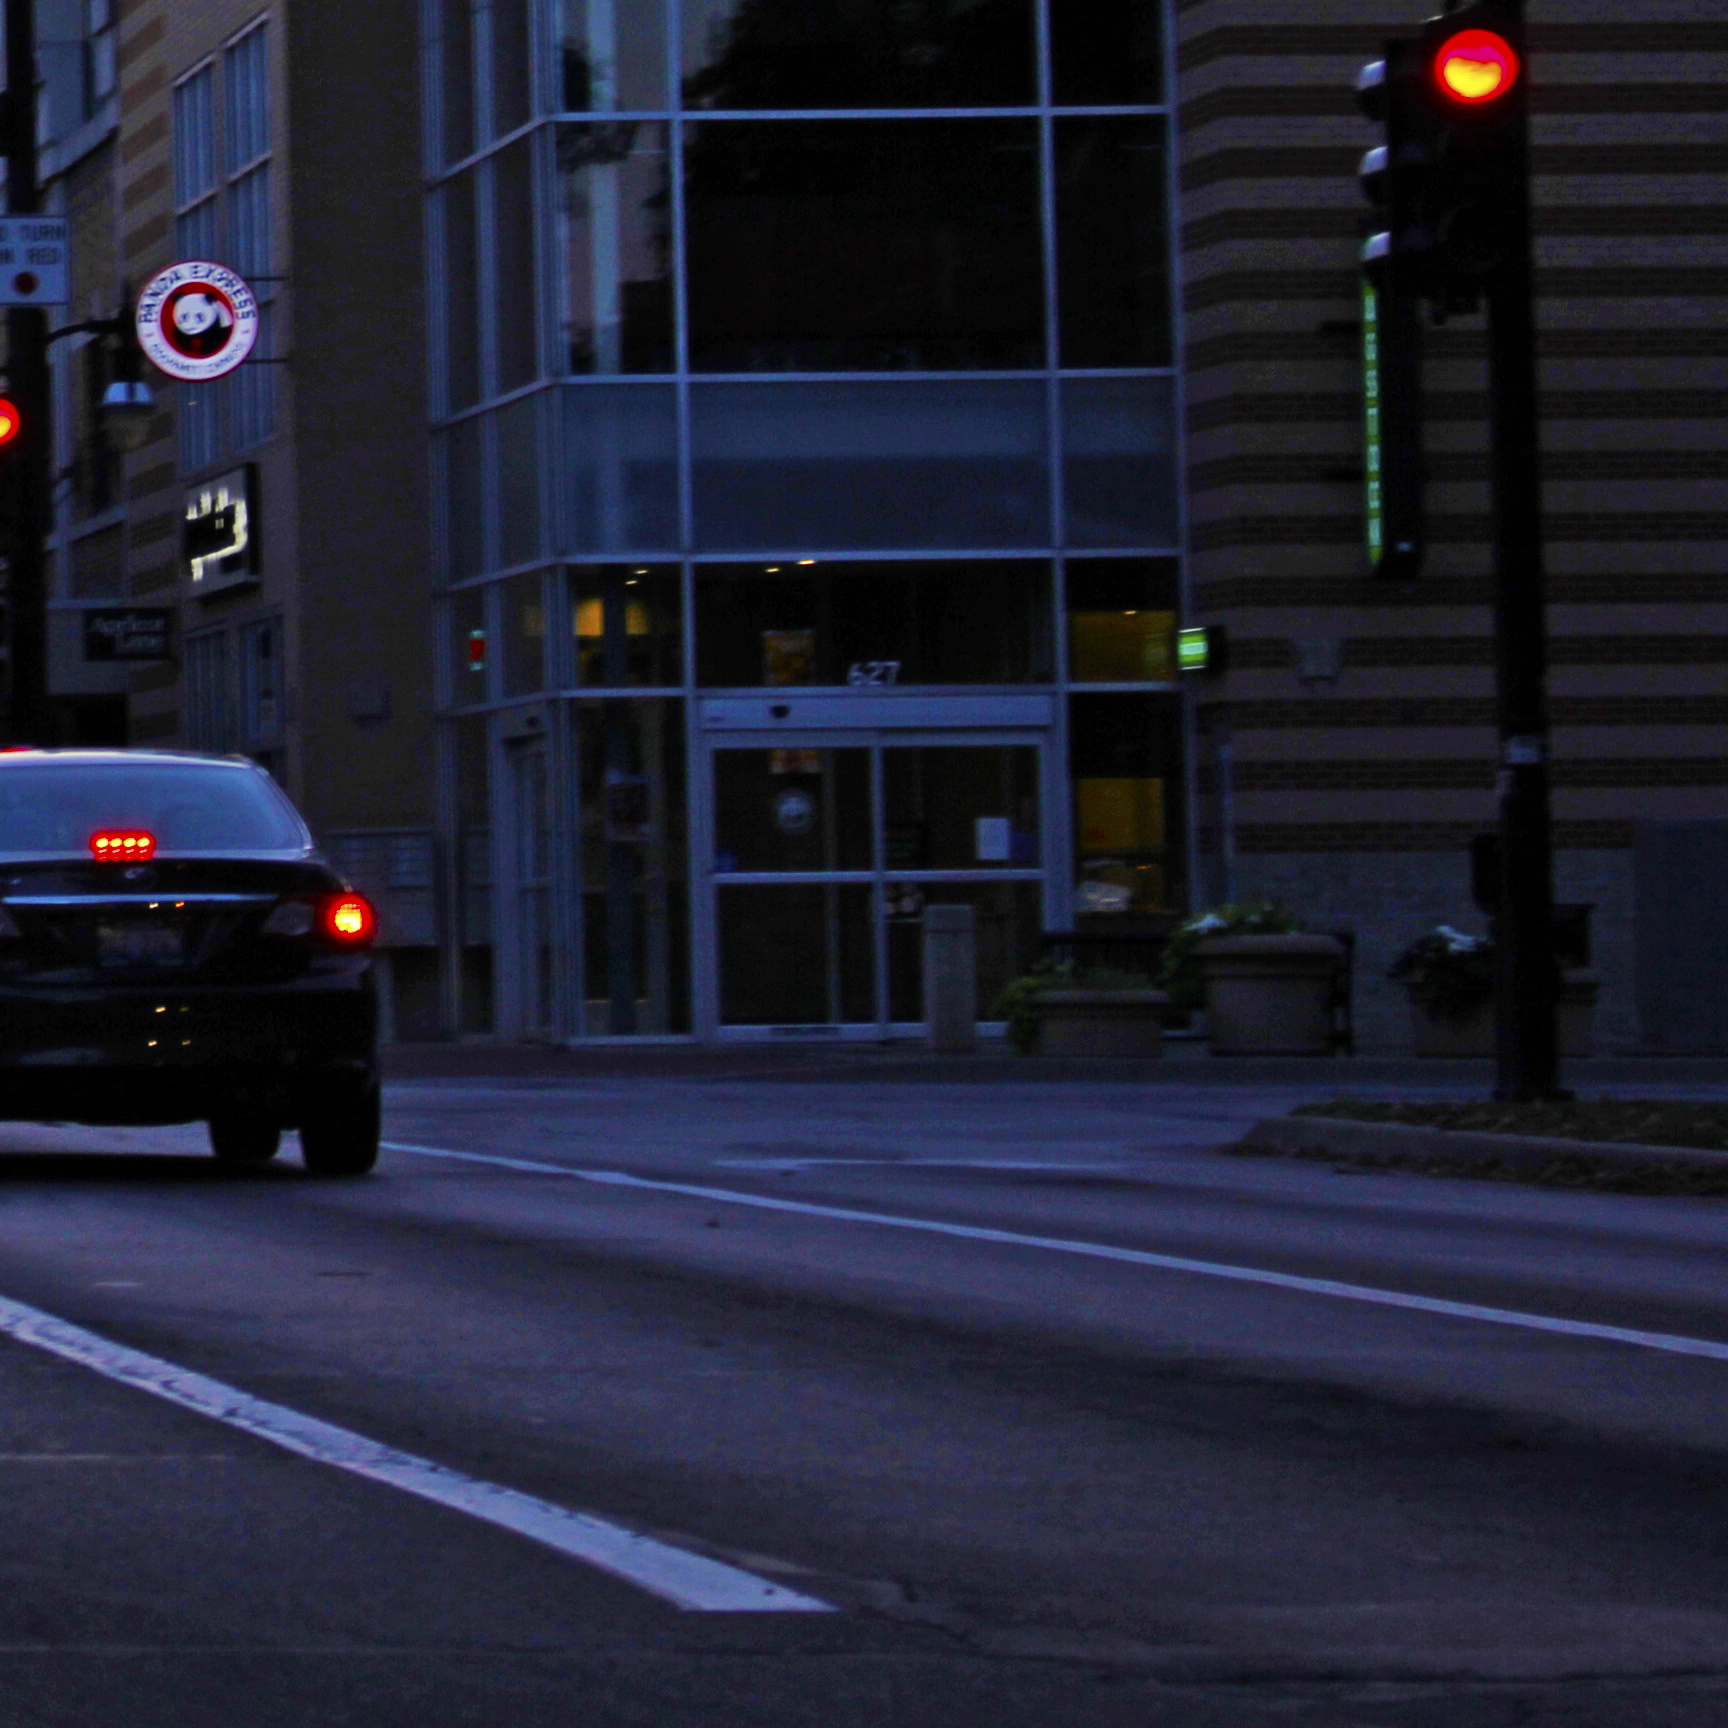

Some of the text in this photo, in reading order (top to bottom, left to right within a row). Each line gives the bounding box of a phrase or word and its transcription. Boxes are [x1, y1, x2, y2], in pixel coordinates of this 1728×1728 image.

[19, 224, 67, 242] TURN
[26, 247, 61, 265] RED
[138, 264, 256, 323] PANDA EXPRESS
[846, 660, 903, 687] 627
